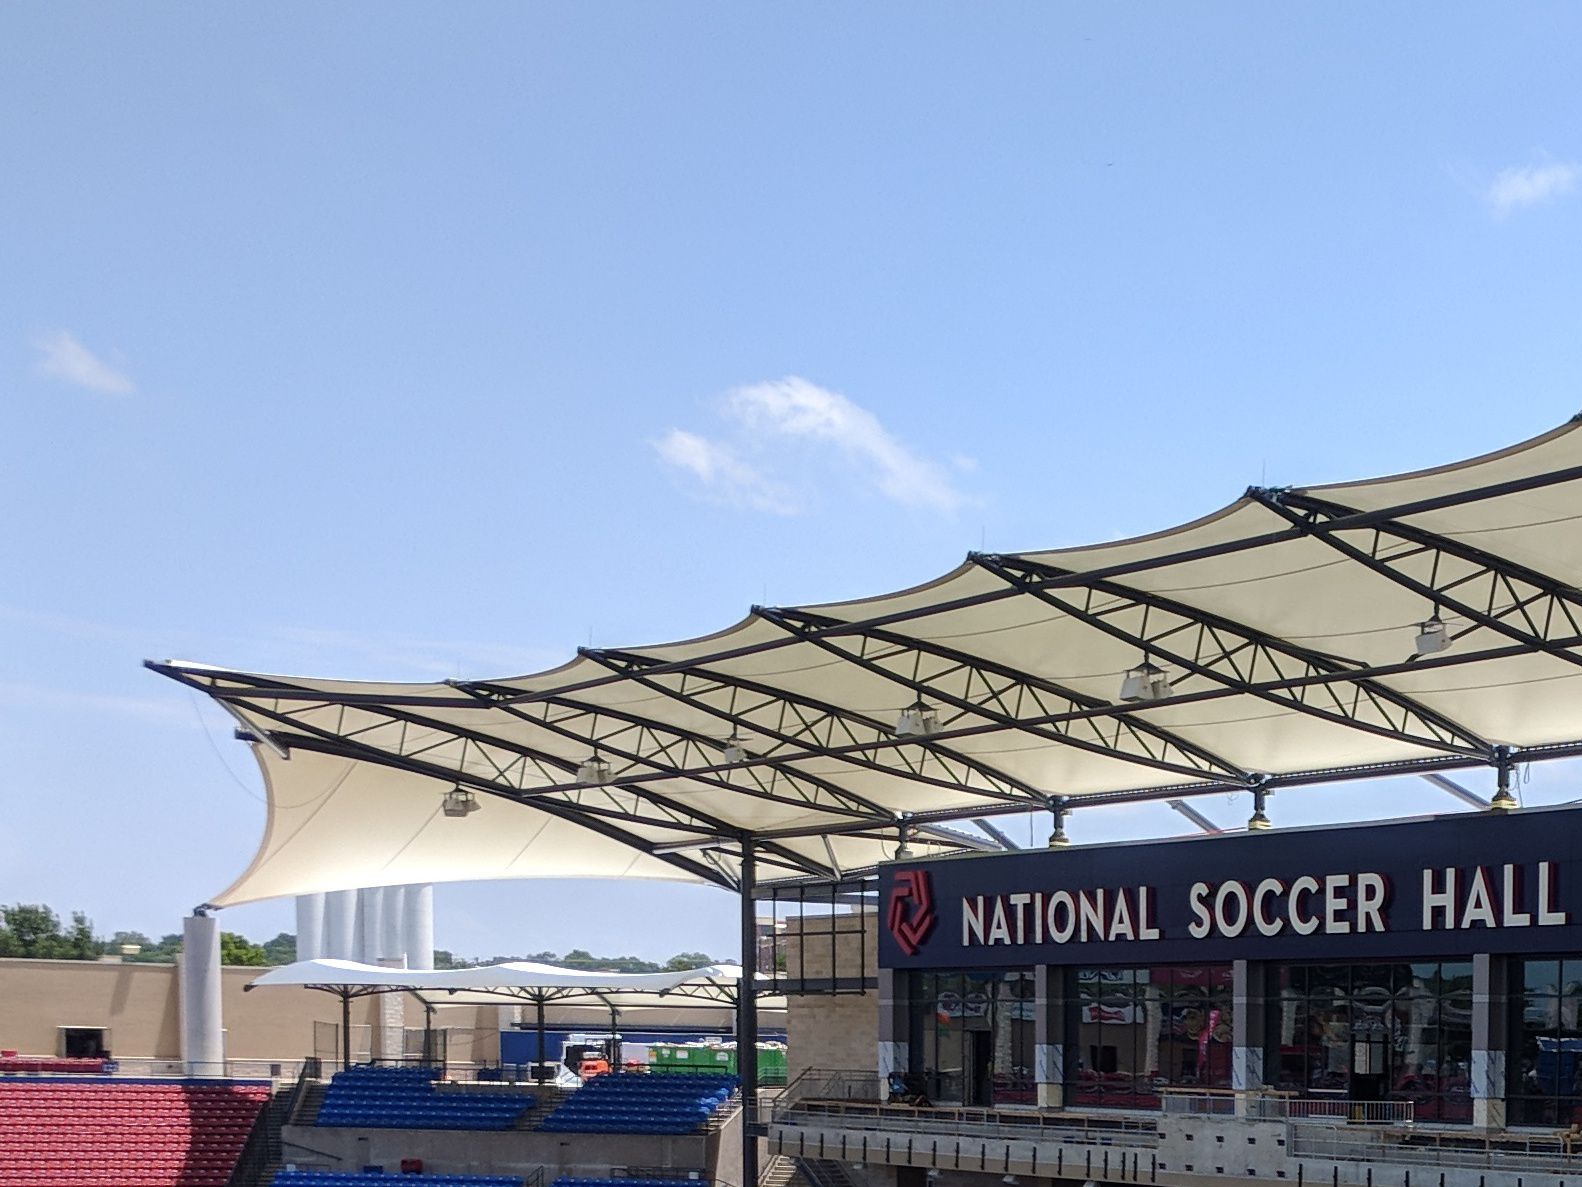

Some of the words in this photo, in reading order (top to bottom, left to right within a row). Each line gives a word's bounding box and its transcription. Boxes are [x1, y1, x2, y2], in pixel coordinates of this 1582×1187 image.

[962, 885, 1160, 947] NATIONAL
[1189, 872, 1387, 939] SOCCER
[1422, 859, 1567, 930] HALL
